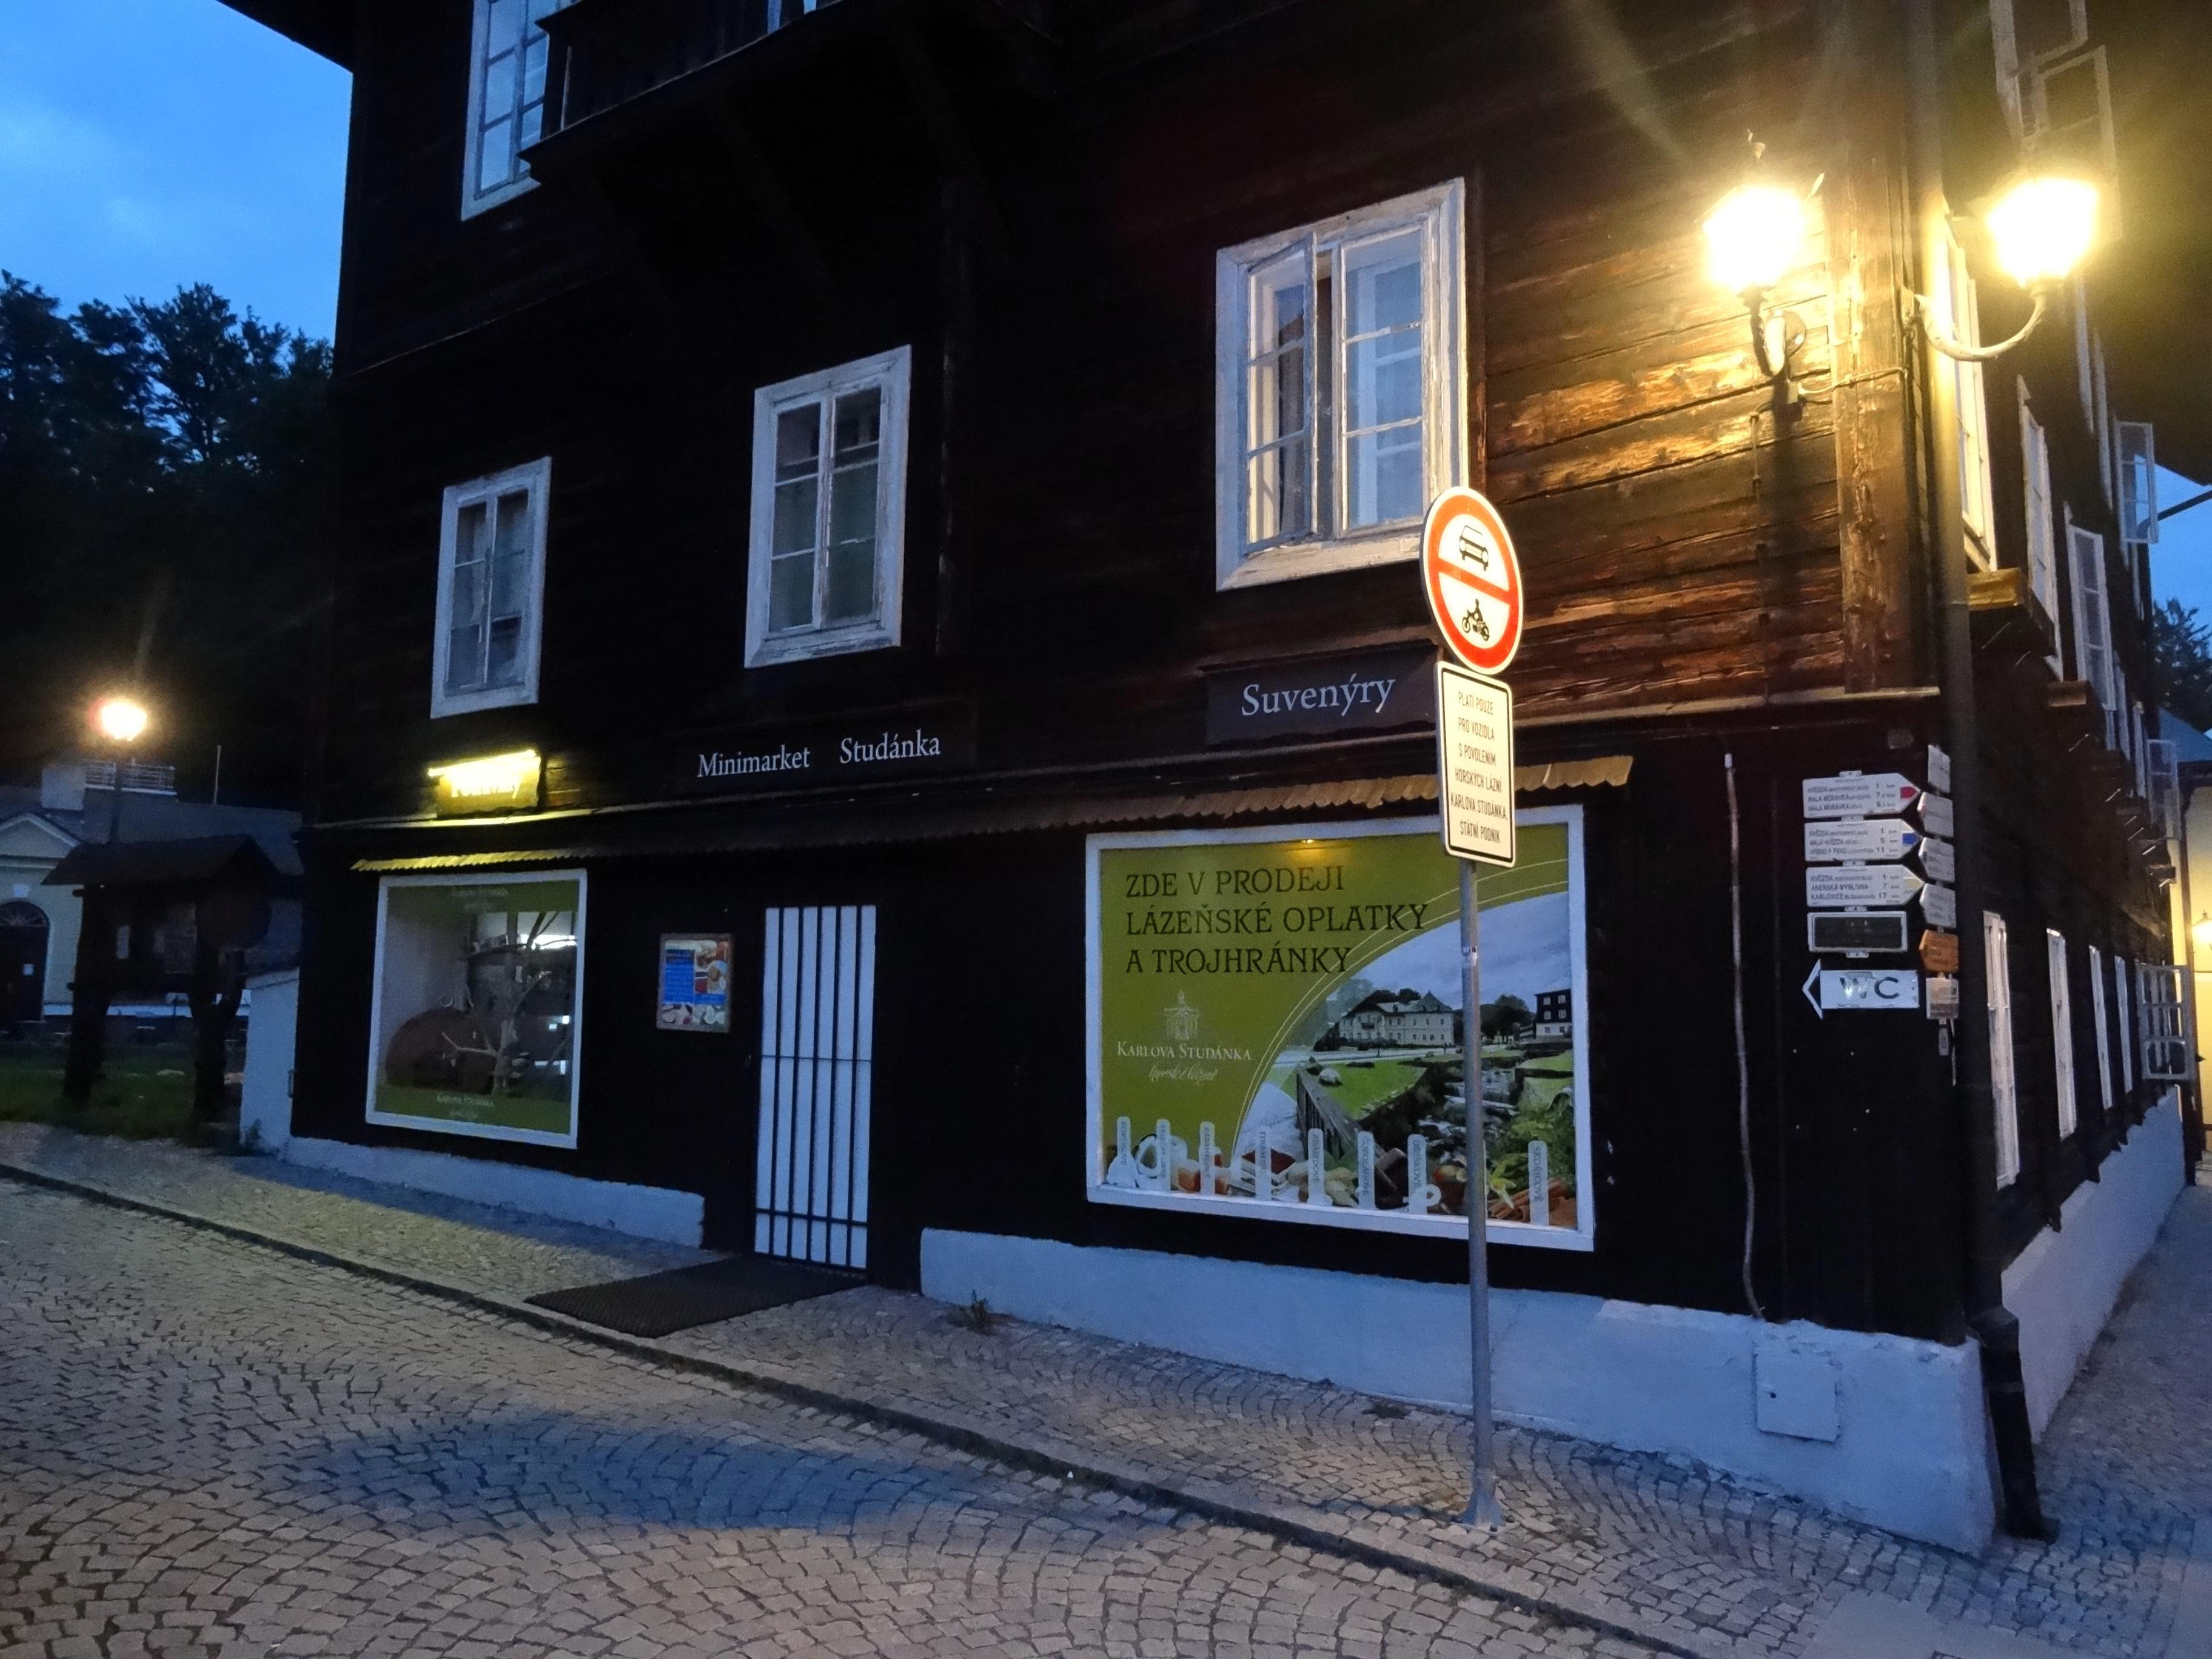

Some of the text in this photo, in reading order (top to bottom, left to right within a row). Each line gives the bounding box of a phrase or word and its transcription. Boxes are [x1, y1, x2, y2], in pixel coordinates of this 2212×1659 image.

[1242, 672, 1396, 717] Suvenýry
[1476, 697, 1493, 716] POUZE
[1458, 717, 1495, 740] PRO VOZIDLA
[697, 728, 941, 778] Minimarket Studánka
[1458, 743, 1496, 766] S POVOLENÍM
[1455, 767, 1502, 793] HORSKÝCH LÁZNÍ
[1450, 792, 1476, 812] KARLOVA
[1460, 819, 1501, 843] STÁTNÍ PODNIK
[1126, 865, 1344, 897] ZDE V PRODEJI
[1127, 901, 1428, 935] LÁZEŇSKÉ OPLATKY
[1125, 941, 1352, 975] A TROJHRÁNKY
